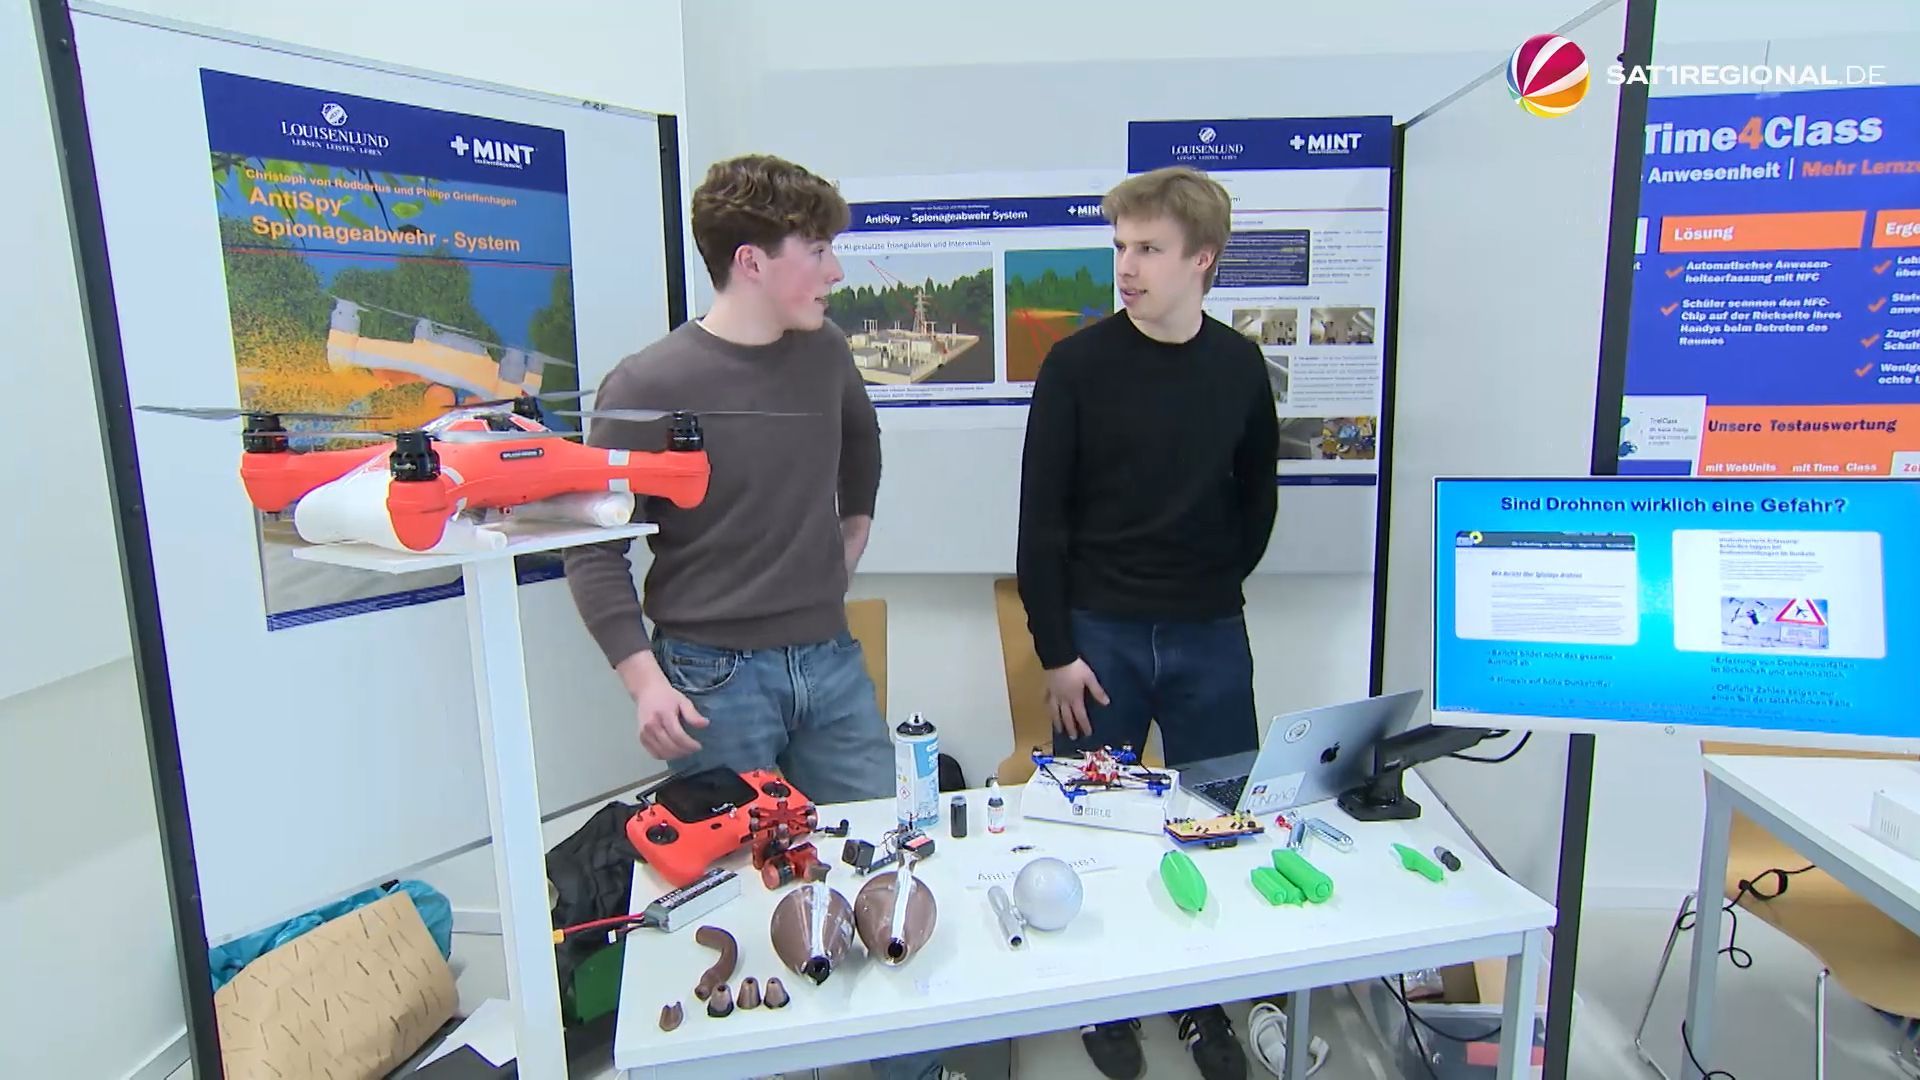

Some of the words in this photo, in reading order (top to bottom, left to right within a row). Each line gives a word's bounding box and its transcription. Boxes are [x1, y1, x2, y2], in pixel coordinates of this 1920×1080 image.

[281, 121, 389, 148] LOUISENLUND
[1645, 114, 1883, 155] Time4Class
[1171, 143, 1243, 155] LOUISENLUND
[1648, 162, 1780, 184] Anwesenheit
[1802, 160, 1856, 177] Mehr
[245, 168, 306, 185] Christoph
[310, 178, 332, 188] von
[334, 178, 391, 194] Rodbertus
[394, 186, 414, 195] und
[416, 187, 450, 200] Philipp
[250, 186, 342, 217] AntiSpy
[865, 213, 901, 224] AntiSpy
[911, 209, 990, 223] Spionageabwehr
[993, 209, 1028, 222] System
[251, 215, 436, 246] Spionageabwehr
[454, 231, 521, 253] System
[1674, 225, 1734, 241] Lösung
[1774, 272, 1794, 282] mit
[1795, 272, 1820, 282] NFC
[1682, 298, 1726, 308] Schüler
[1728, 300, 1776, 308] scannen
[1779, 299, 1800, 307] den
[1681, 311, 1706, 322] Chip
[1708, 311, 1729, 321] auf
[1731, 311, 1751, 320] der
[1752, 310, 1810, 320] Rückseite
[1680, 324, 1721, 334] Handys
[1723, 323, 1752, 332] beim
[1754, 323, 1804, 332] Betreten
[1806, 322, 1828, 332] des
[1679, 337, 1725, 346] Raumes
[1708, 420, 1762, 432] Unsere
[1770, 419, 1897, 433] Testauswertung
[1706, 463, 1723, 472] mit
[1726, 463, 1776, 472] WebUnits
[1792, 463, 1811, 472] mit
[1813, 463, 1840, 472] Time
[1846, 462, 1877, 472] Class
[1501, 497, 1541, 511] Sind
[1547, 497, 1625, 511] Drohnen
[1631, 497, 1706, 512] wirklich
[1712, 498, 1754, 512] eine
[1760, 497, 1846, 513] Gefahr?
